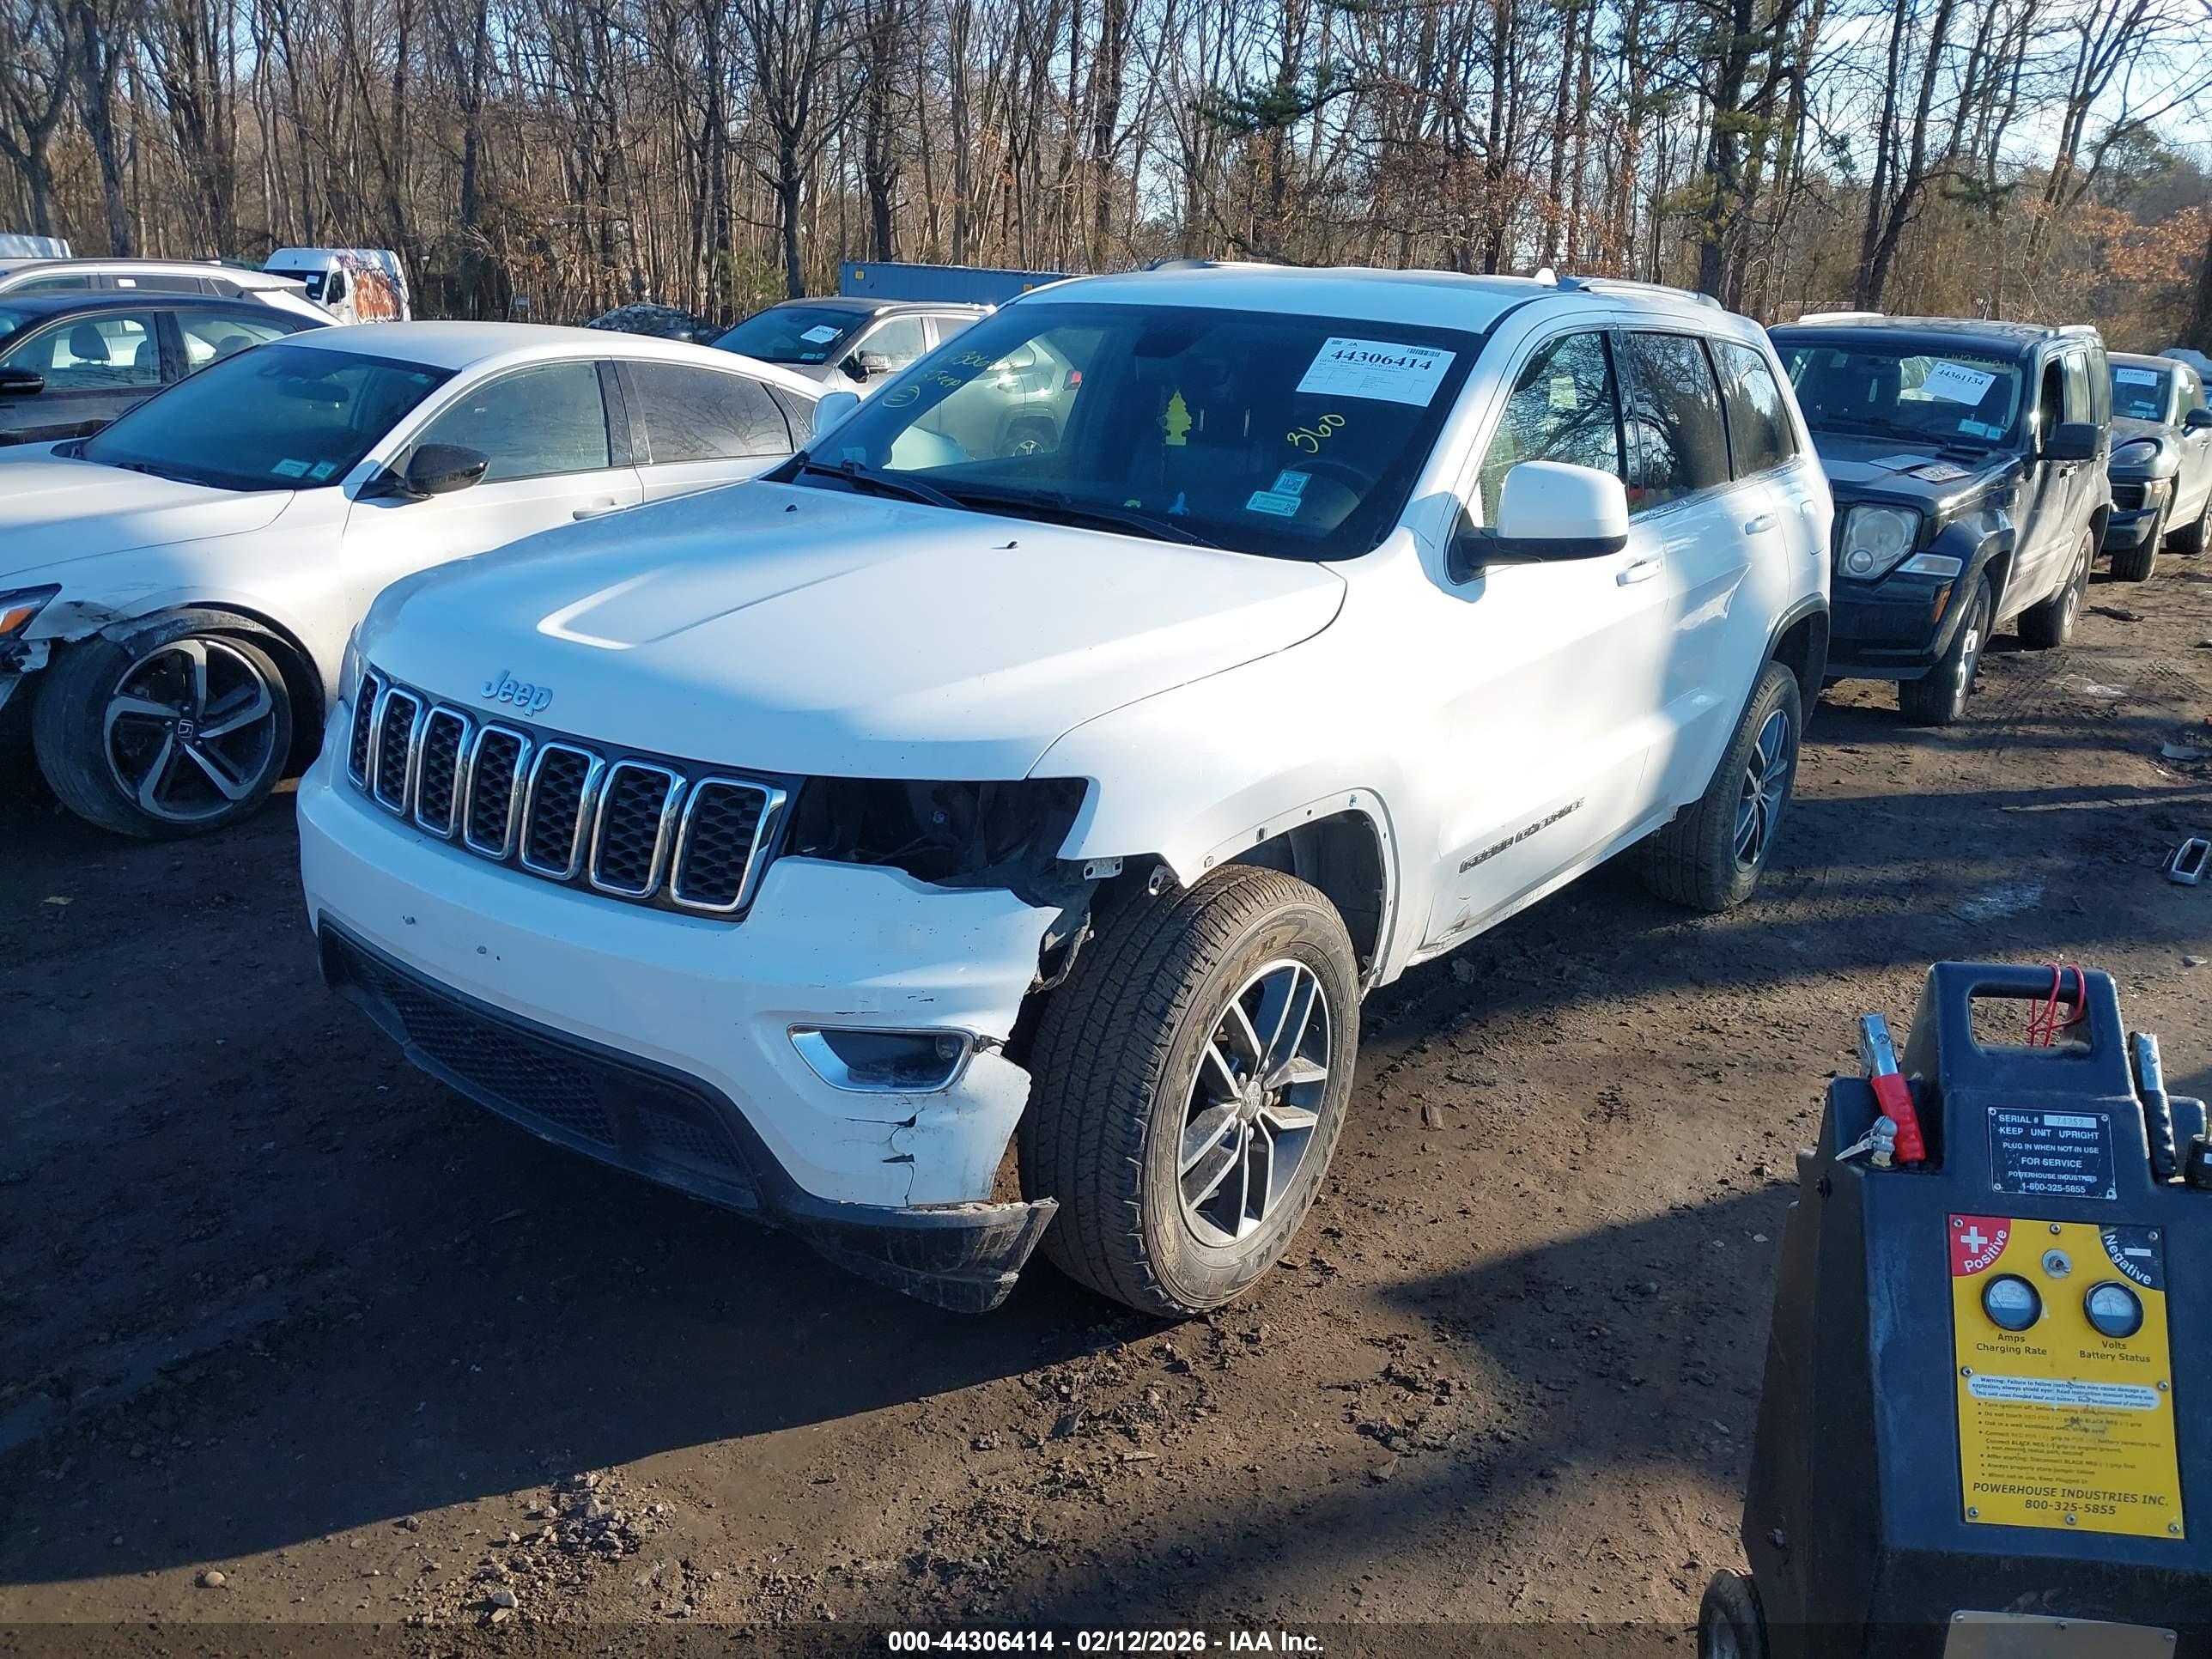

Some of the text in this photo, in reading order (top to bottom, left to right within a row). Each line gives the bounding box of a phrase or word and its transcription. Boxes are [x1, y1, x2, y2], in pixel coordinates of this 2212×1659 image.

[1331, 349, 1433, 370] 44306414
[1286, 414, 1346, 453] 360
[481, 670, 553, 716] Jeep
[1998, 1115, 2032, 1124] SERIAL
[2000, 1127, 2100, 1139] KEEP UNIT UPRIGHT
[2021, 1157, 2082, 1168] FOR SERVICE
[2008, 1170, 2056, 1180] POWERHOUSE
[2021, 1183, 2086, 1194] 1-800-325-5855
[1964, 1230, 2008, 1273] Positive
[2104, 1234, 2152, 1285] Negative
[1997, 1333, 2026, 1343] Amps
[1977, 1342, 2047, 1356] Charging Rate
[2101, 1340, 2127, 1350] Volts
[2079, 1350, 2151, 1363] Battery Status
[1972, 1482, 2169, 1506] POWERHOUSE INDUSTRIES INC.
[2025, 1499, 2117, 1516] 800-325-5855
